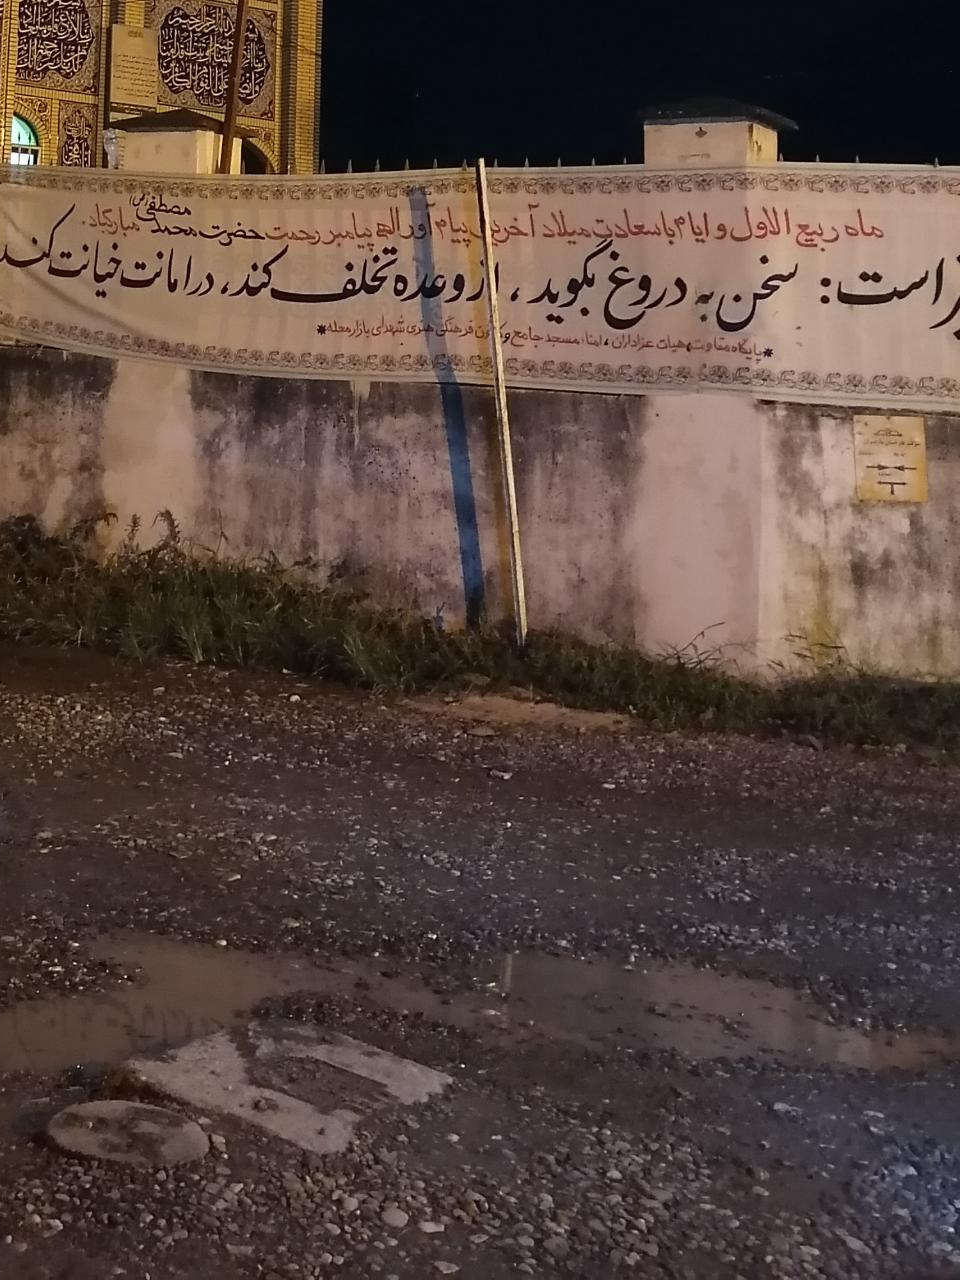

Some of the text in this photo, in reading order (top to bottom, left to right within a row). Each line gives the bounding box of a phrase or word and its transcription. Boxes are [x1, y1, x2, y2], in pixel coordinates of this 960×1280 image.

[136, 193, 192, 222] مصطفی
[844, 208, 884, 238] ماه
[151, 218, 198, 238] محمد
[198, 222, 266, 247] حضرت
[265, 226, 321, 245] رحمت
[321, 212, 375, 252] پیامبر
[542, 209, 591, 244] میلاد
[673, 210, 710, 243] ایام
[714, 223, 728, 240] و
[730, 206, 790, 242] الاول
[796, 223, 839, 252] ربیع
[46, 240, 123, 299] خیانت
[120, 247, 192, 295] امانت
[270, 245, 399, 304] تخلف
[393, 272, 466, 304] وعده
[603, 250, 688, 330] دروغ
[716, 254, 799, 332] سخن
[695, 290, 715, 323] به
[510, 325, 544, 348] جامع
[545, 333, 580, 348] مسجد
